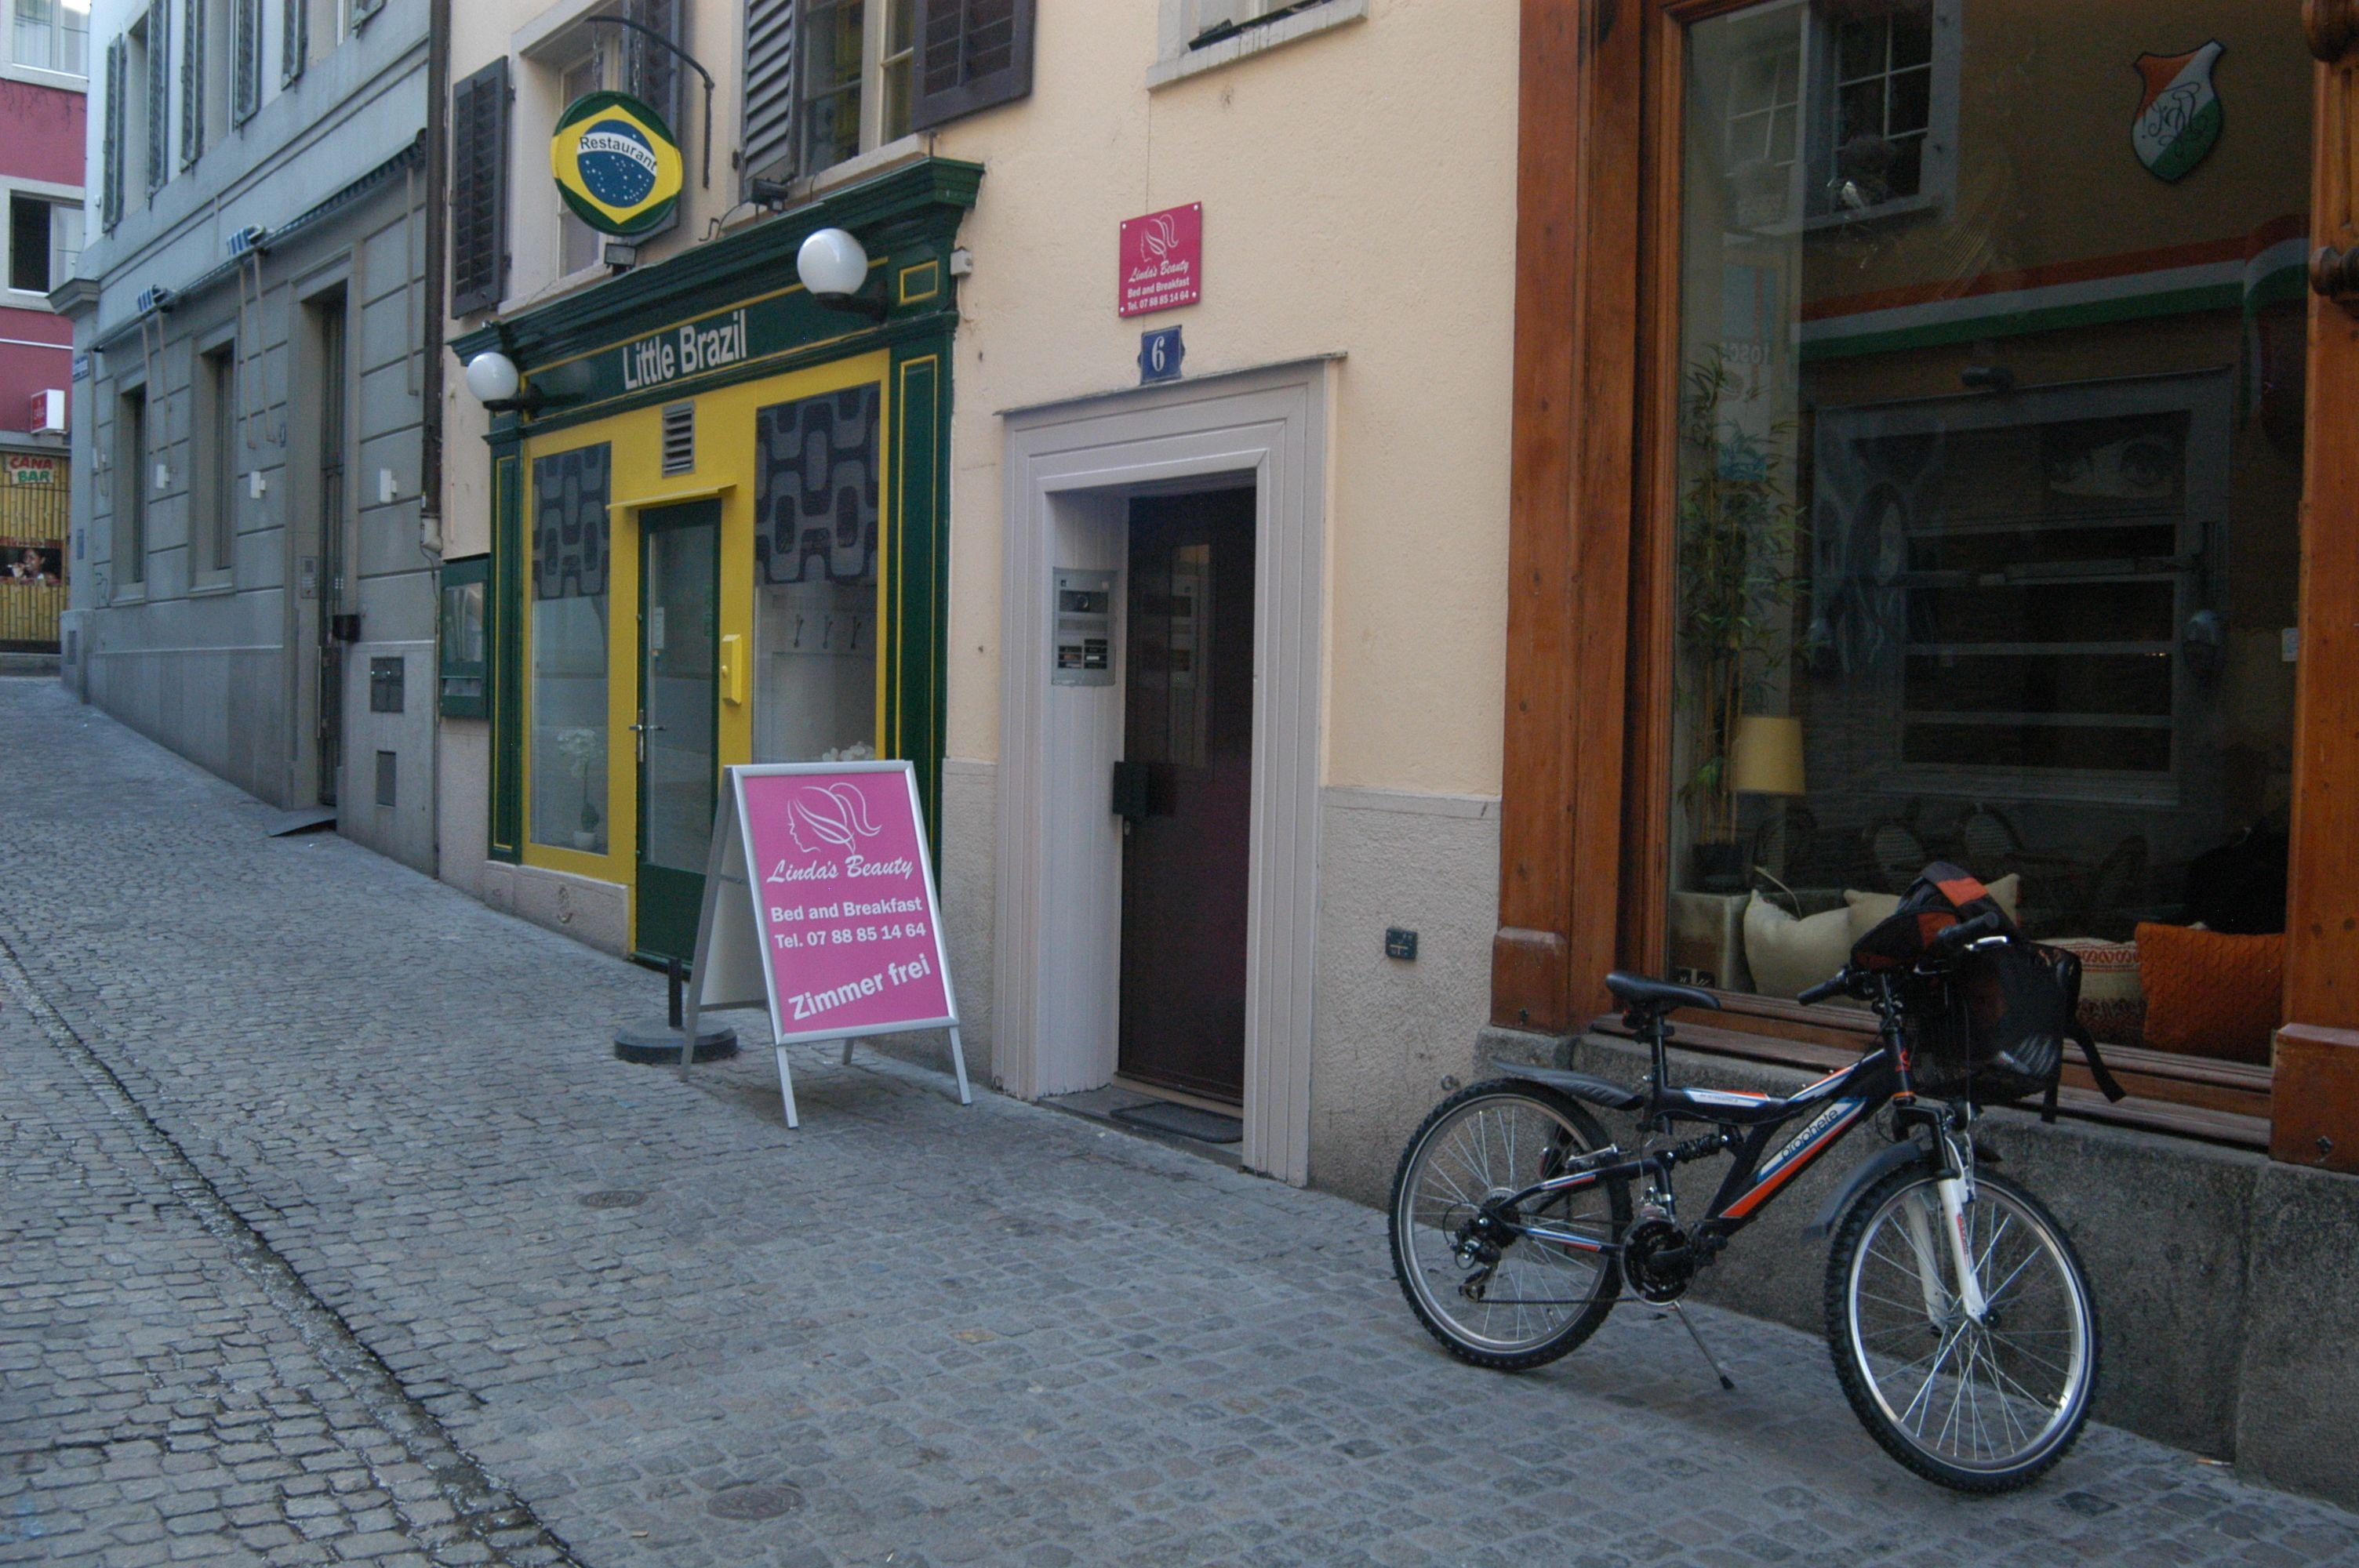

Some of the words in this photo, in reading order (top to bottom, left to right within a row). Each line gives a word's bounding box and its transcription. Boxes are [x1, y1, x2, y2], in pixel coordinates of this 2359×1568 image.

[580, 136, 657, 171] Restaurant
[1129, 265, 1158, 282] Linda's
[1160, 260, 1189, 274] Beauty
[1128, 287, 1141, 298] Bed
[1142, 283, 1155, 295] and
[1156, 277, 1190, 292] Breakfast
[1128, 301, 1138, 312] Tel.
[1140, 299, 1148, 309] 07
[1149, 296, 1158, 307] 88
[1159, 294, 1169, 305] 85
[1169, 292, 1178, 303] 14
[1180, 290, 1189, 300] 64
[623, 336, 675, 390] Little
[680, 309, 747, 374] Brazil
[1152, 336, 1165, 372] 6
[9, 455, 54, 470] CANA
[17, 470, 50, 484] BAR
[766, 859, 839, 884] Linda's
[845, 855, 914, 880] Beauty
[771, 906, 805, 923] Bed
[809, 903, 839, 920] and
[842, 897, 923, 916] Breakfast
[775, 933, 803, 949] Tel.
[806, 931, 827, 946] 07
[831, 929, 852, 944] 88
[856, 927, 878, 942] 85
[881, 924, 902, 940] 14
[905, 923, 926, 938] 64
[788, 973, 884, 1021] Zimmer
[888, 953, 931, 986] frei
[1781, 1108, 1839, 1162] prophete
